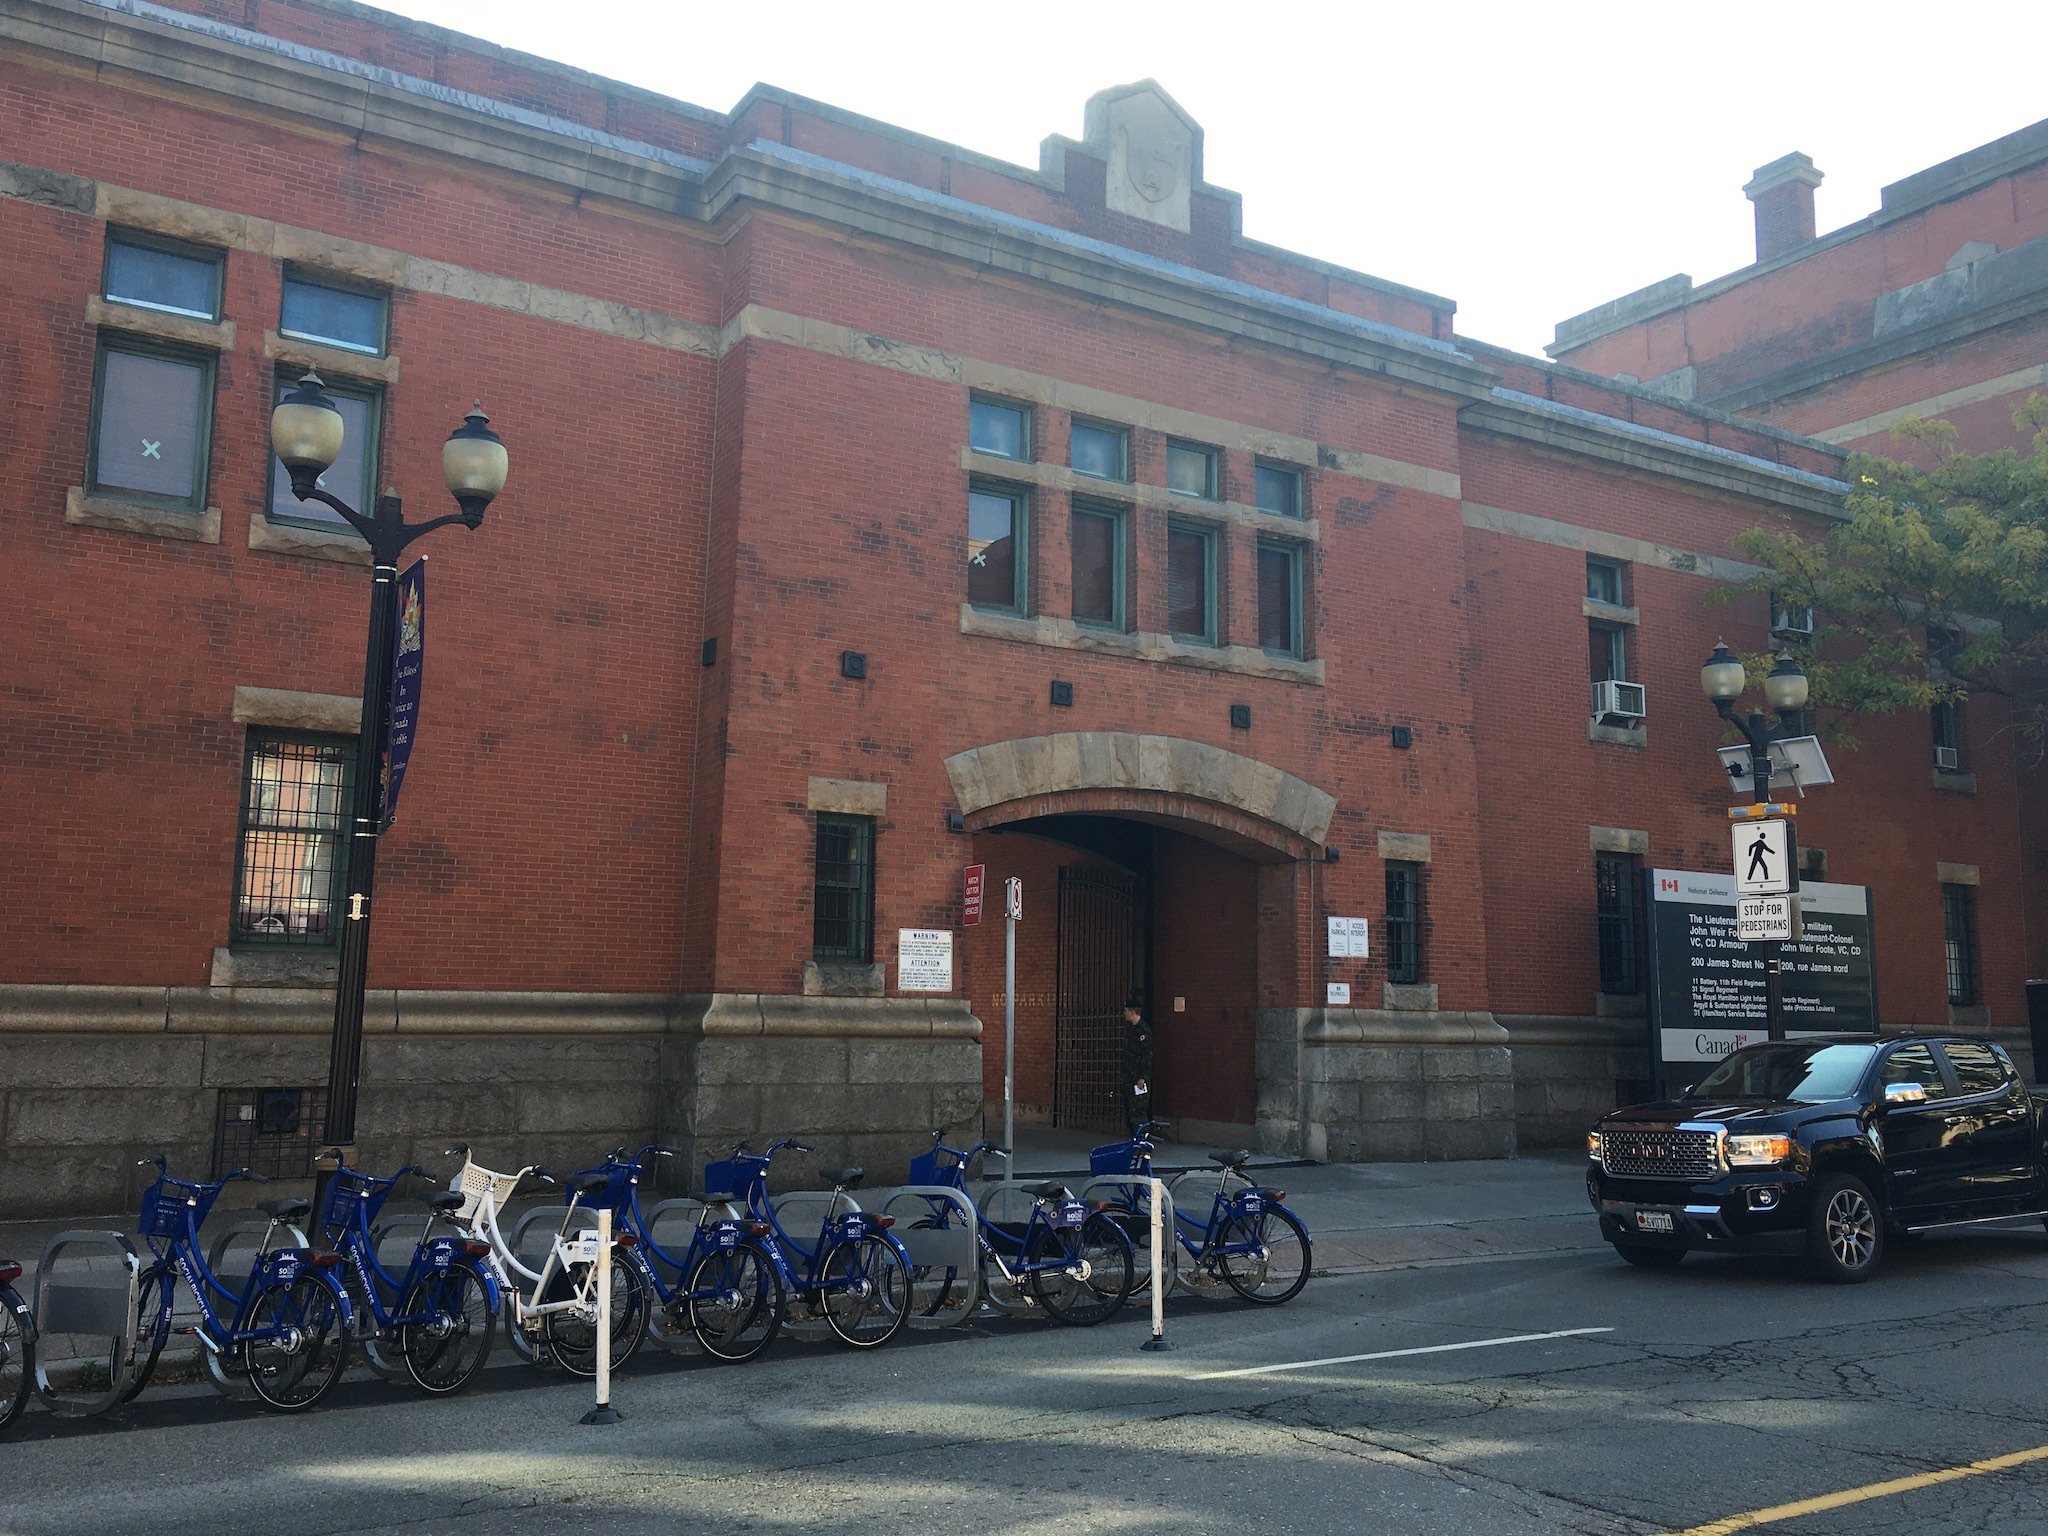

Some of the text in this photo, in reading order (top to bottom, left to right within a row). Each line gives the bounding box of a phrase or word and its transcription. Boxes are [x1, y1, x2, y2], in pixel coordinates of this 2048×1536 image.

[1744, 904, 1782, 916] STOP FOR
[1689, 914, 1738, 925] The Lieutenan
[1741, 920, 1787, 931] PEDESTRIANS
[1807, 922, 1833, 931] militaire
[1690, 926, 1708, 935] John
[1710, 927, 1726, 937] Weir
[1690, 937, 1749, 951] VC, CD Armoury
[1801, 933, 1854, 944] utenant-Colonel
[1780, 943, 1861, 955] John Weir Foote, VC, CD
[1691, 957, 1704, 967] 200
[1707, 958, 1730, 968] James
[1732, 959, 1752, 969] Street
[1781, 962, 1795, 972] 200,
[1810, 963, 1831, 972] James
[1834, 965, 1848, 973] nord
[1744, 980, 1766, 988] Regiment
[992, 993, 1006, 1007] NO
[1703, 994, 1716, 1002] Royal
[1740, 995, 1752, 1003] Light
[1702, 1010, 1726, 1018] (Hamilton)
[1696, 1034, 1743, 1055] Canad
